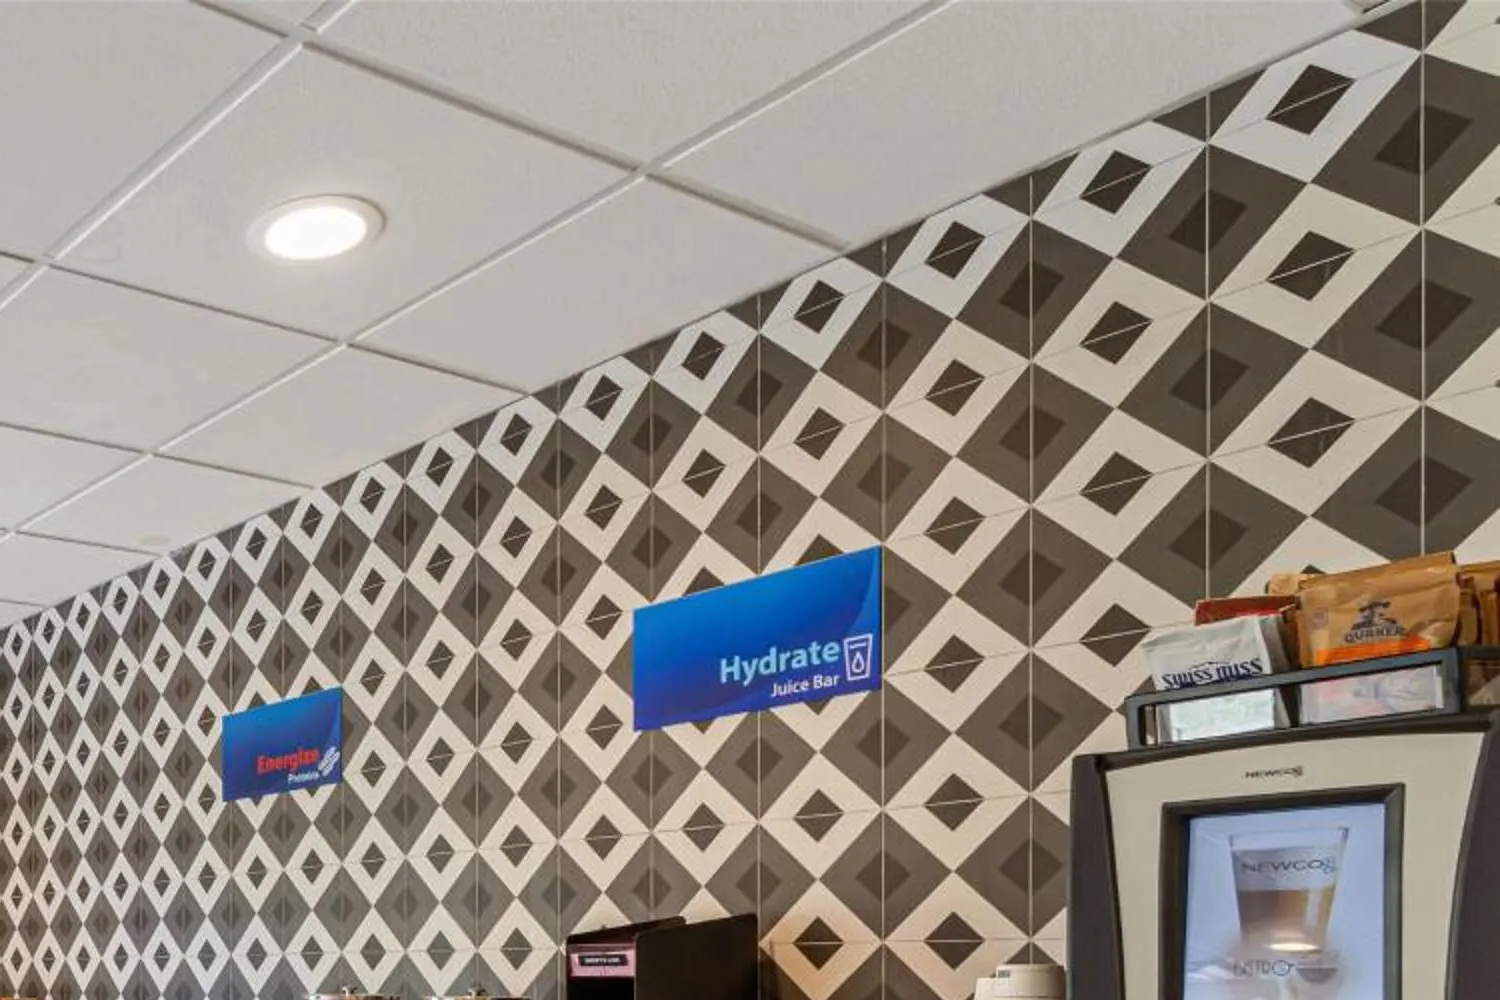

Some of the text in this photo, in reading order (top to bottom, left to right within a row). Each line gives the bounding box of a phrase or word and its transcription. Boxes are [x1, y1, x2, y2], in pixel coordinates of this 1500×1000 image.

[720, 641, 840, 686] Hydrate
[771, 674, 840, 698] Juice Bar
[256, 748, 320, 775] Energize
[1241, 859, 1324, 873] NEWCO
